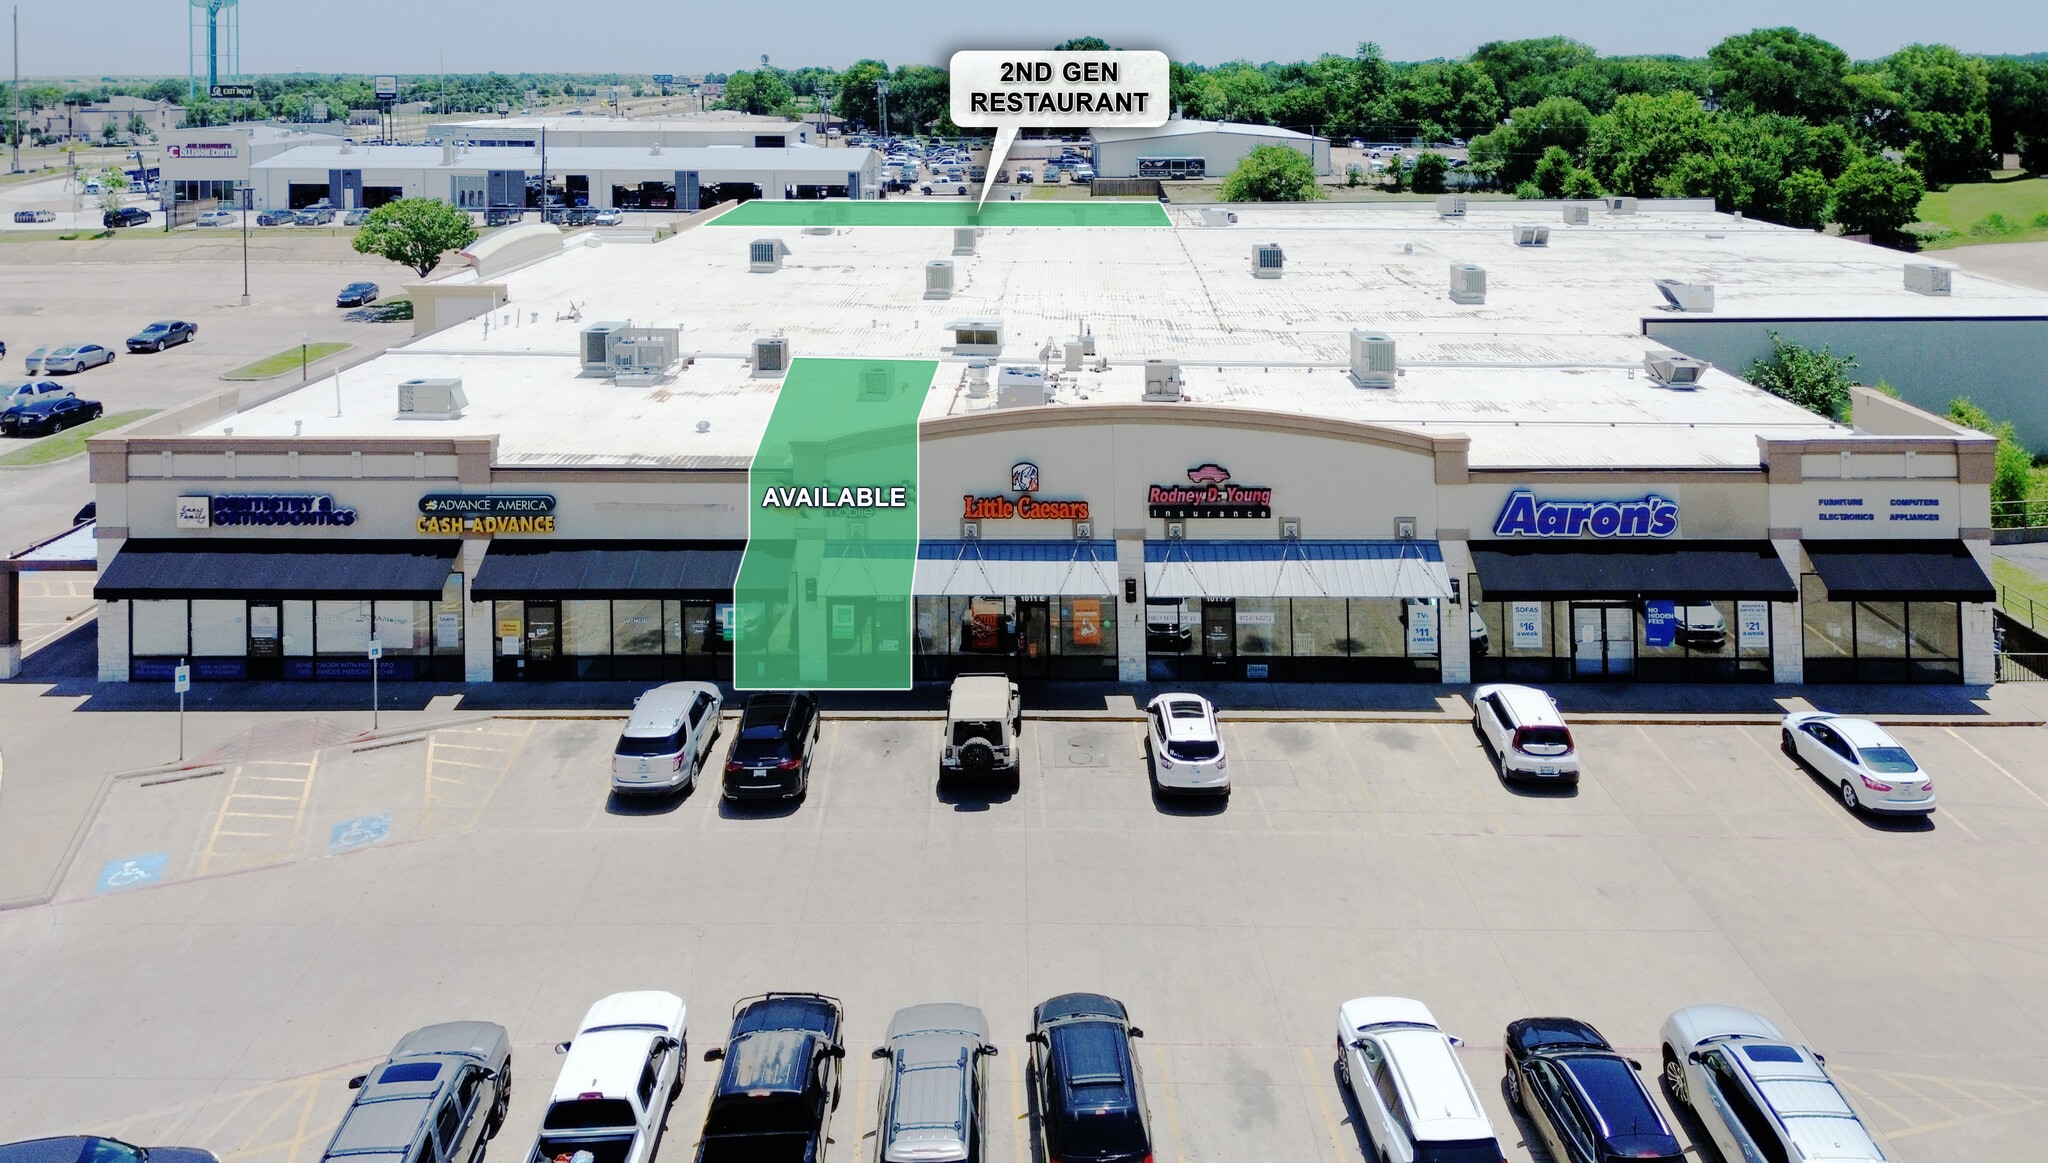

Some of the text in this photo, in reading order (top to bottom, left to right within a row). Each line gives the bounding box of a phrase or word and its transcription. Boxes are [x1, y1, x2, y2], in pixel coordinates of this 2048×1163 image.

[1149, 486, 1271, 506] Rodney D. Young
[213, 495, 333, 511] DENTISTRY &
[438, 500, 548, 511] ADVANCE AMERICA
[1818, 498, 1863, 506] FURNITURE
[1890, 498, 1939, 506] COMPUTERS
[963, 495, 1089, 520] Little Caesars
[213, 509, 357, 527] ORTHODONTICS
[1153, 509, 1266, 518] Insurance
[1494, 490, 1680, 538] Aaron's
[1818, 513, 1874, 521] ELECTRONICS
[1889, 513, 1940, 521] APPLIANCES
[416, 515, 555, 533] CASH ADVANCE
[1520, 622, 1534, 631] $16
[1745, 622, 1760, 631] $21
[1416, 628, 1429, 637] $11
